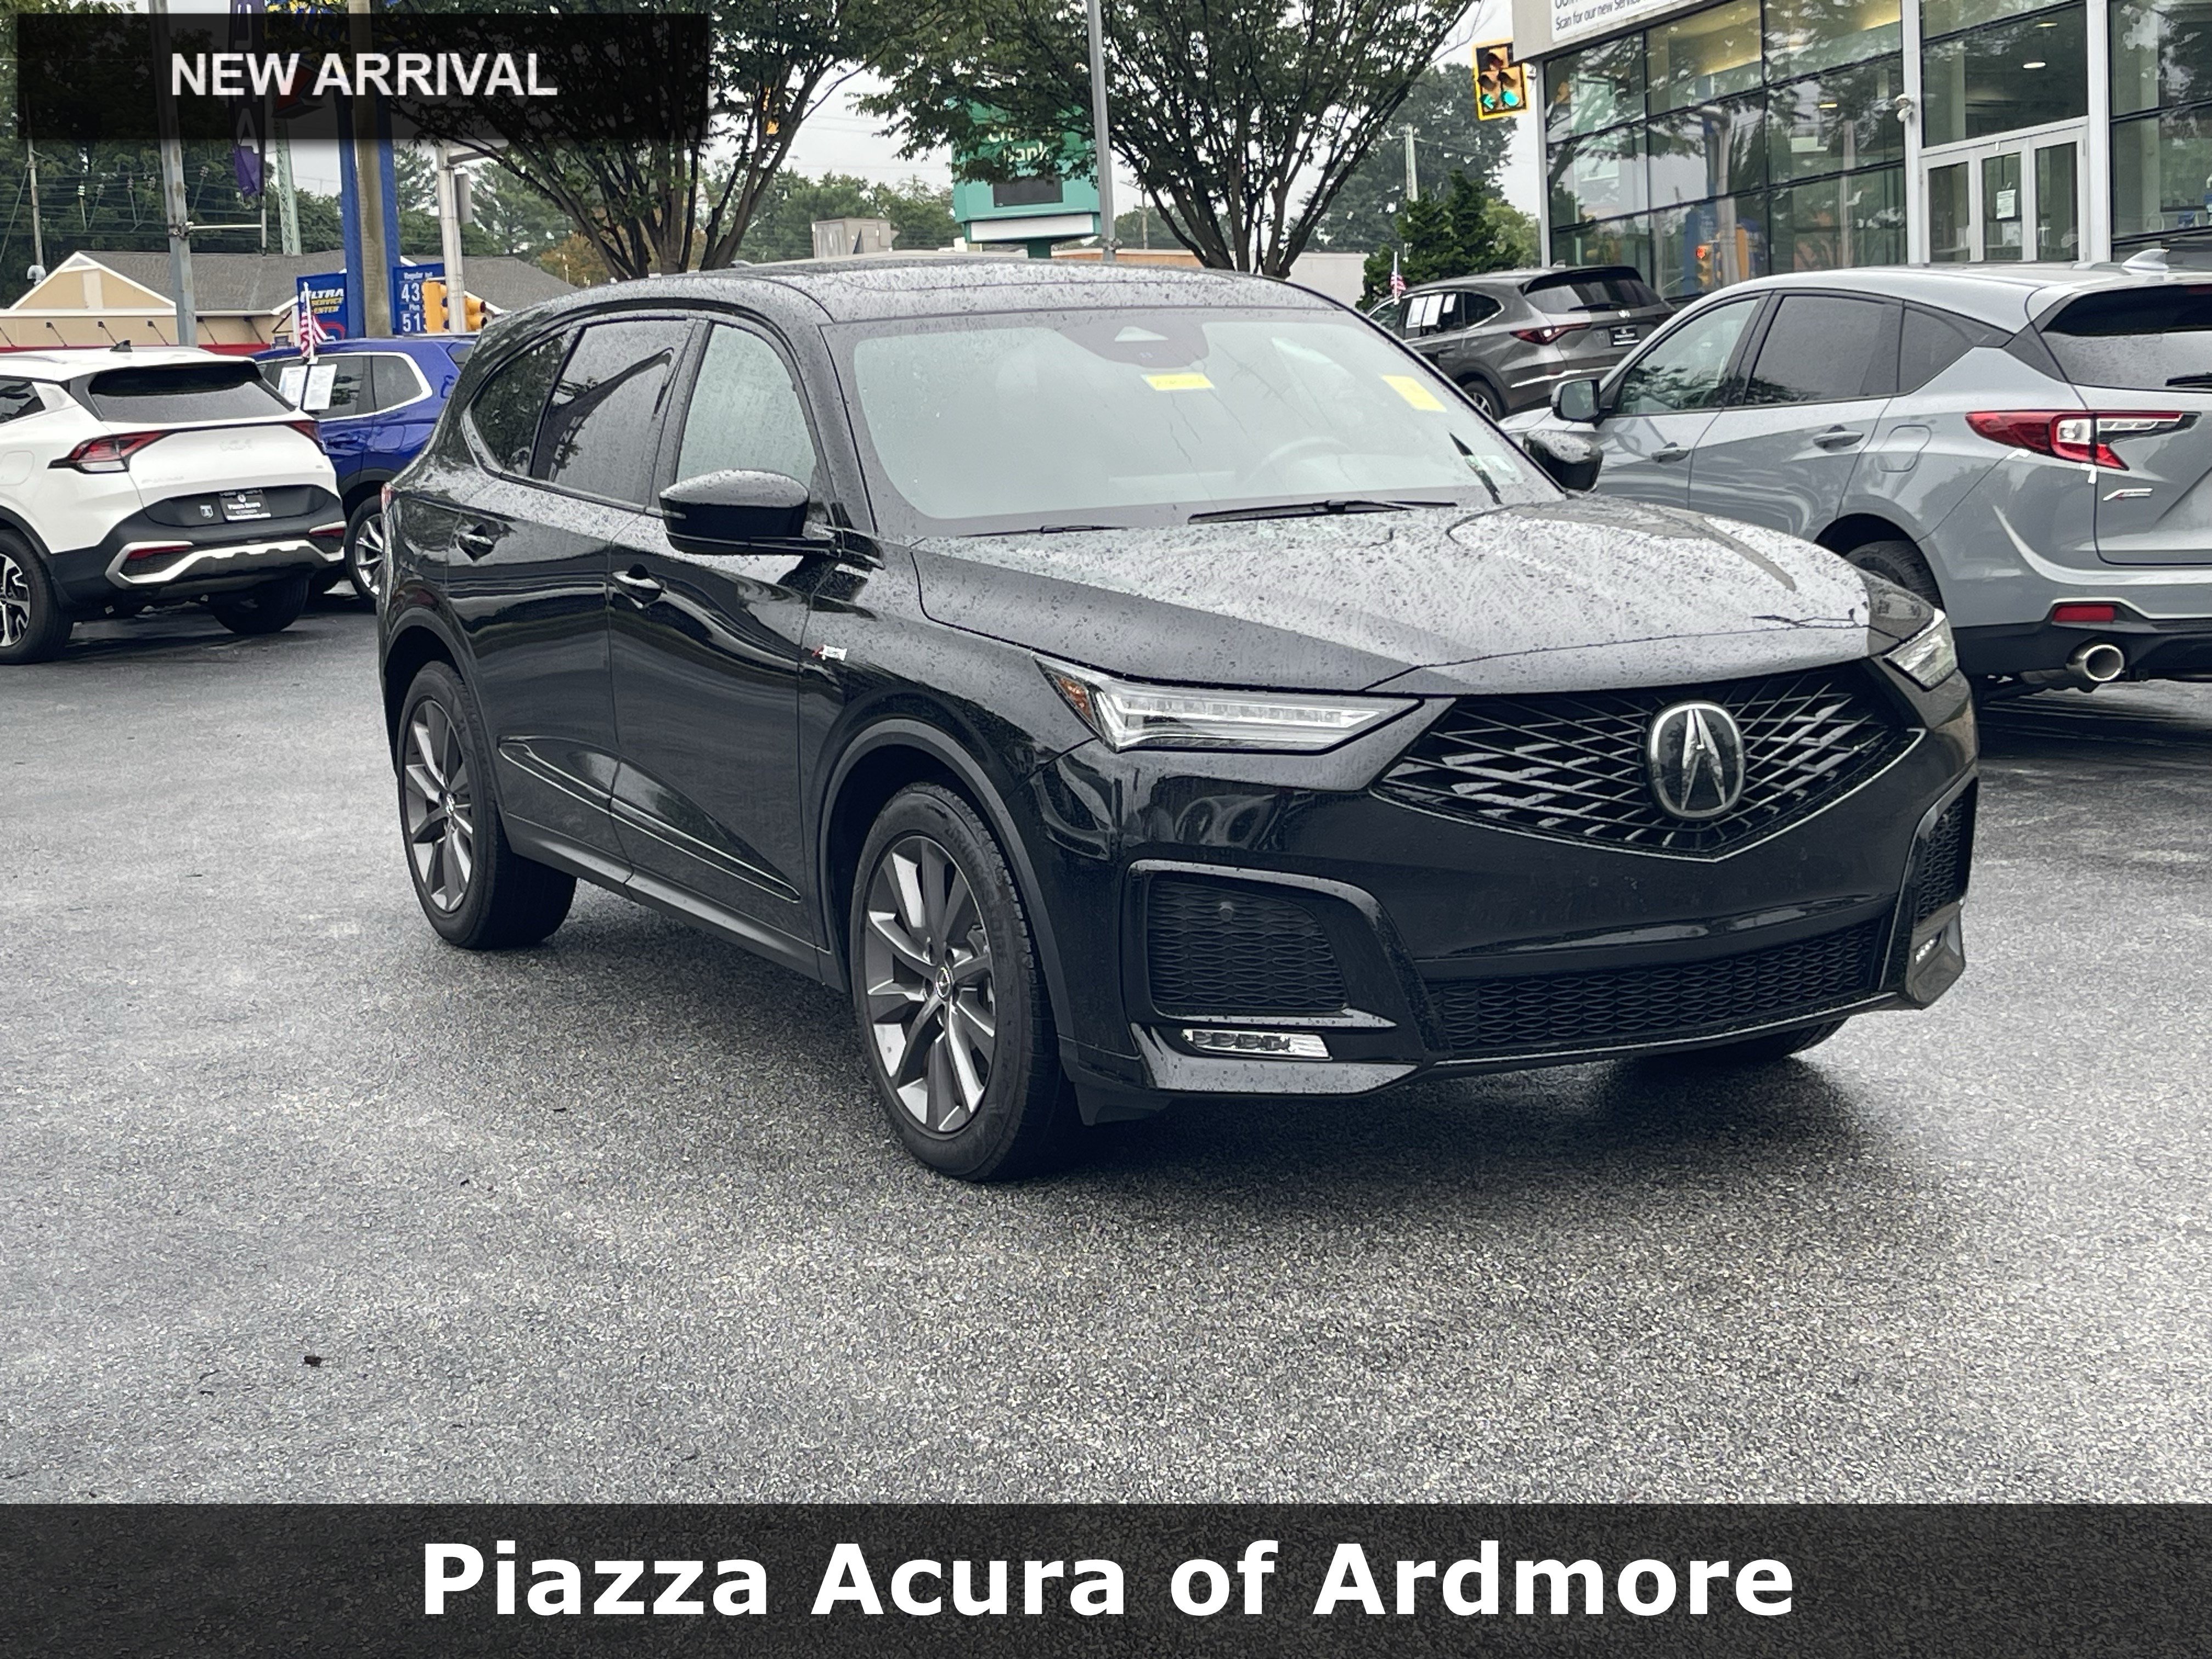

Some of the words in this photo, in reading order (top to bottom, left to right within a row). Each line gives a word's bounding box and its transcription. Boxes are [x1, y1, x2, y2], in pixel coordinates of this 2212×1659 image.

[1555, 16, 1572, 31] Scan
[1573, 11, 1583, 25] for
[1584, 7, 1596, 21] our
[1597, 3, 1613, 15] new
